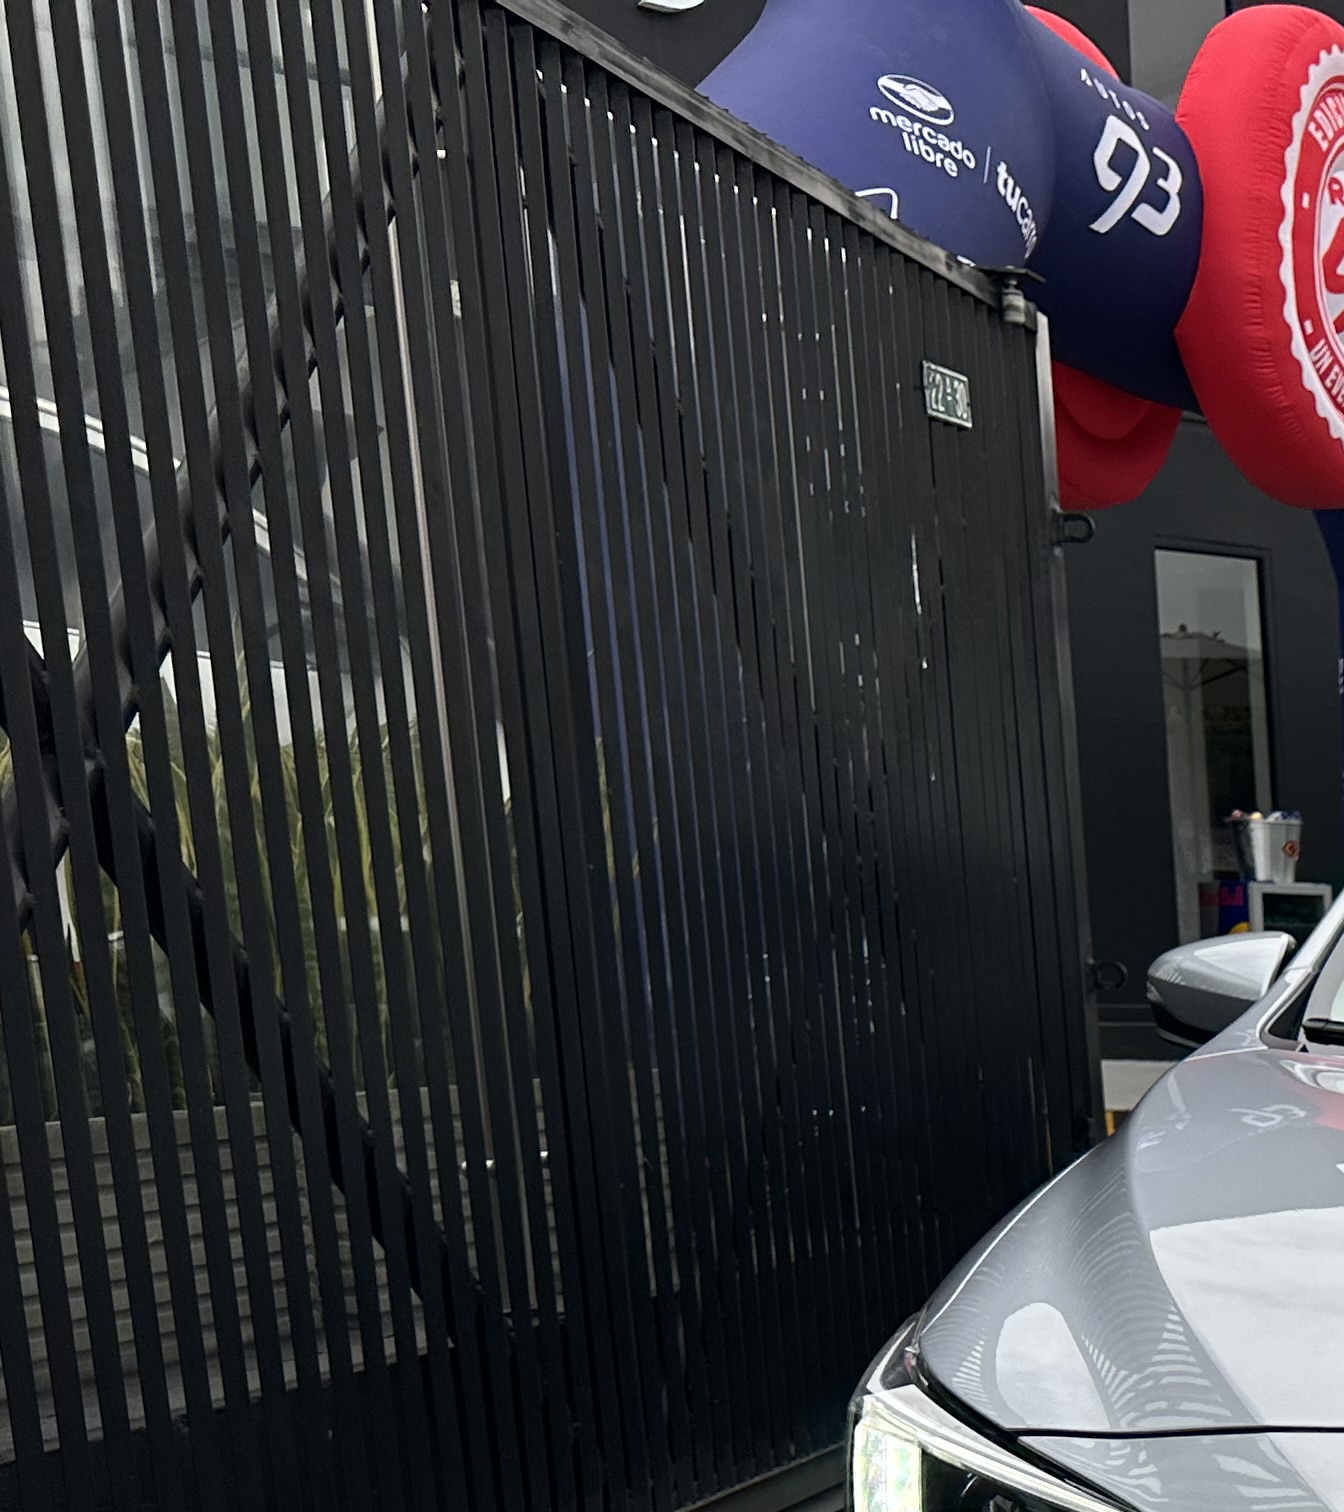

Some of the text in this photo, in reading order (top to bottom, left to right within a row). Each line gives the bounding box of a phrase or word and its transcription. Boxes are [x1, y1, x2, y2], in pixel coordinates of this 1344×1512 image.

[869, 105, 976, 170] mercado
[902, 131, 959, 178] libre
[1088, 114, 1183, 236] 93
